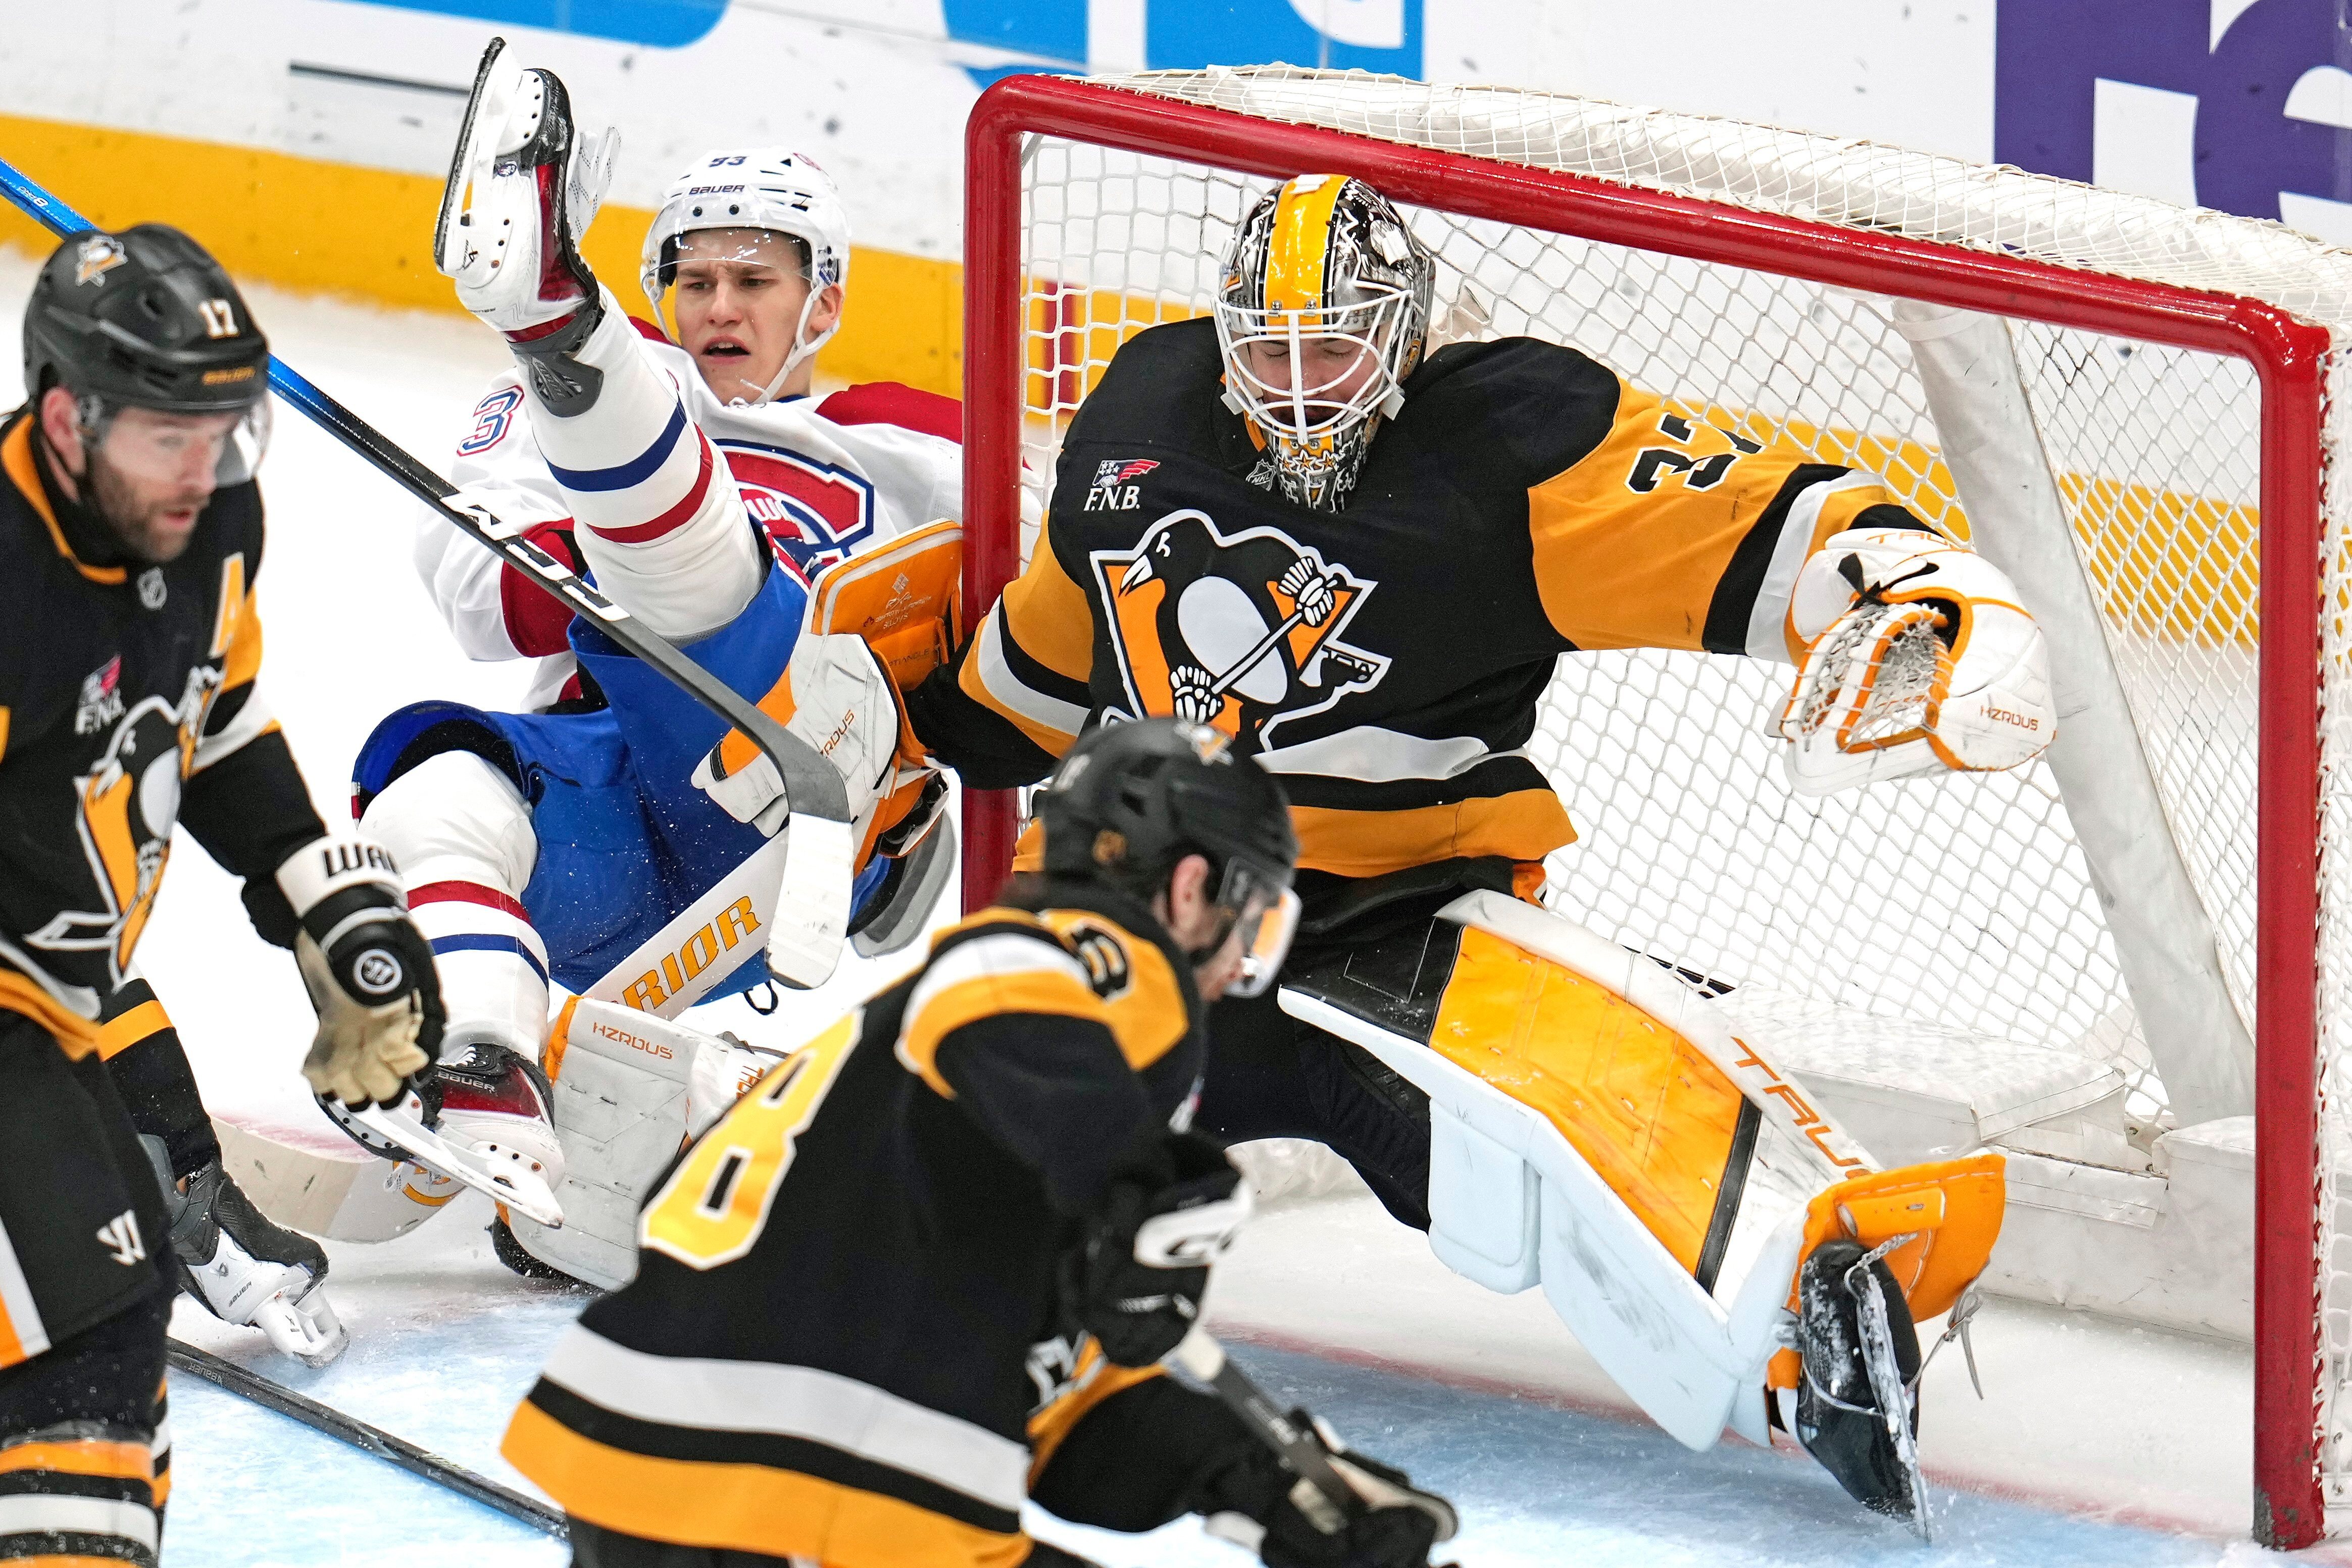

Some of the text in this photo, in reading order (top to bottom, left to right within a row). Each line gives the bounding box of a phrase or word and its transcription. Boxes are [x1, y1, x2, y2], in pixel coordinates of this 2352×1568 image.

[709, 156, 747, 168] 93
[689, 185, 745, 195] BAUER
[198, 299, 240, 339] 17
[622, 895, 762, 1011] RIOR
[593, 1022, 673, 1060] HZRDUS
[1730, 1036, 1872, 1180] TRU
